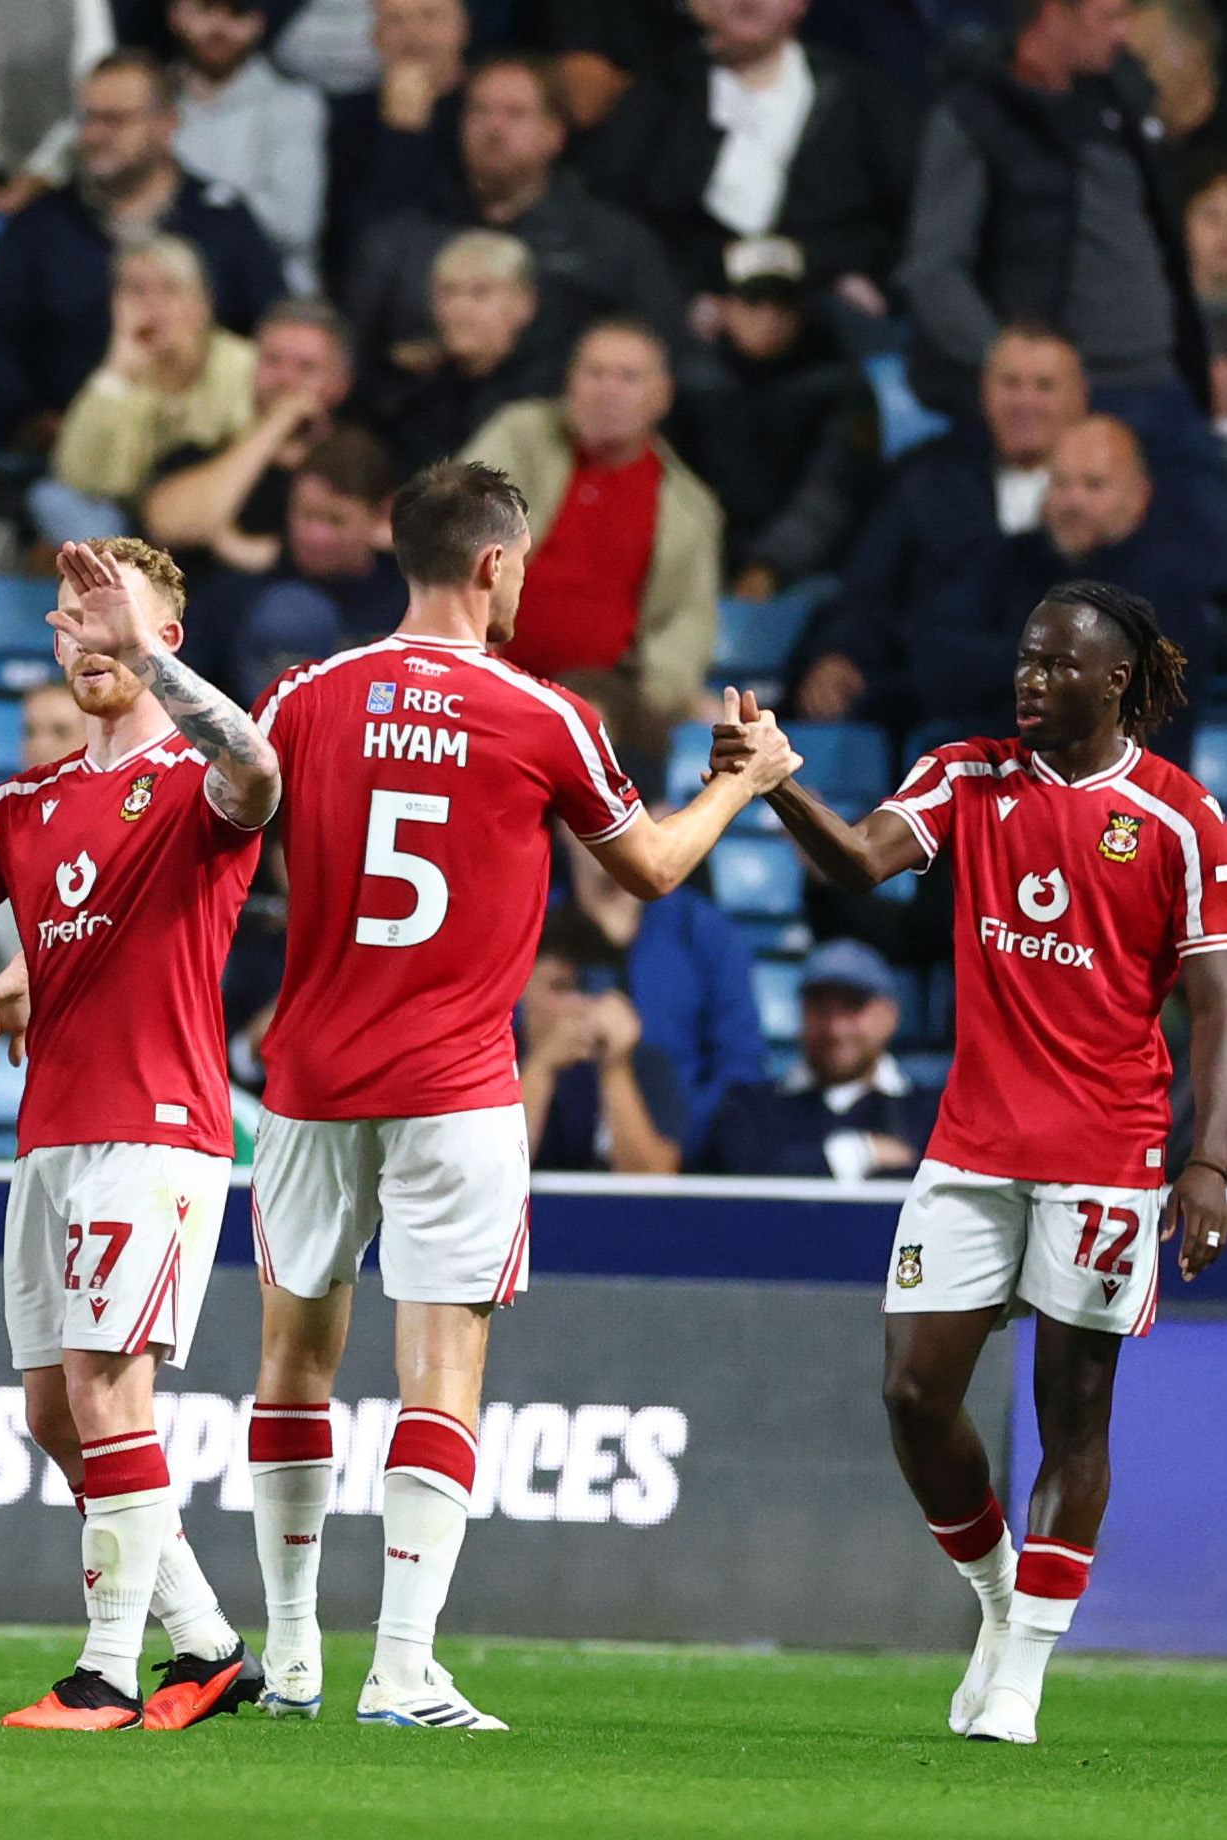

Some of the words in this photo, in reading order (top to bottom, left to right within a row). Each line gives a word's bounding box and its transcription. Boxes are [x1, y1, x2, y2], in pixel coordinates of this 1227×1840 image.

[403, 687, 464, 718] RBC
[363, 721, 468, 768] HYAM
[355, 789, 450, 948] 5
[981, 916, 1095, 970] Firefox
[65, 1221, 133, 1290] 27
[1074, 1199, 1139, 1275] 12
[387, 1547, 420, 1563] 1864
